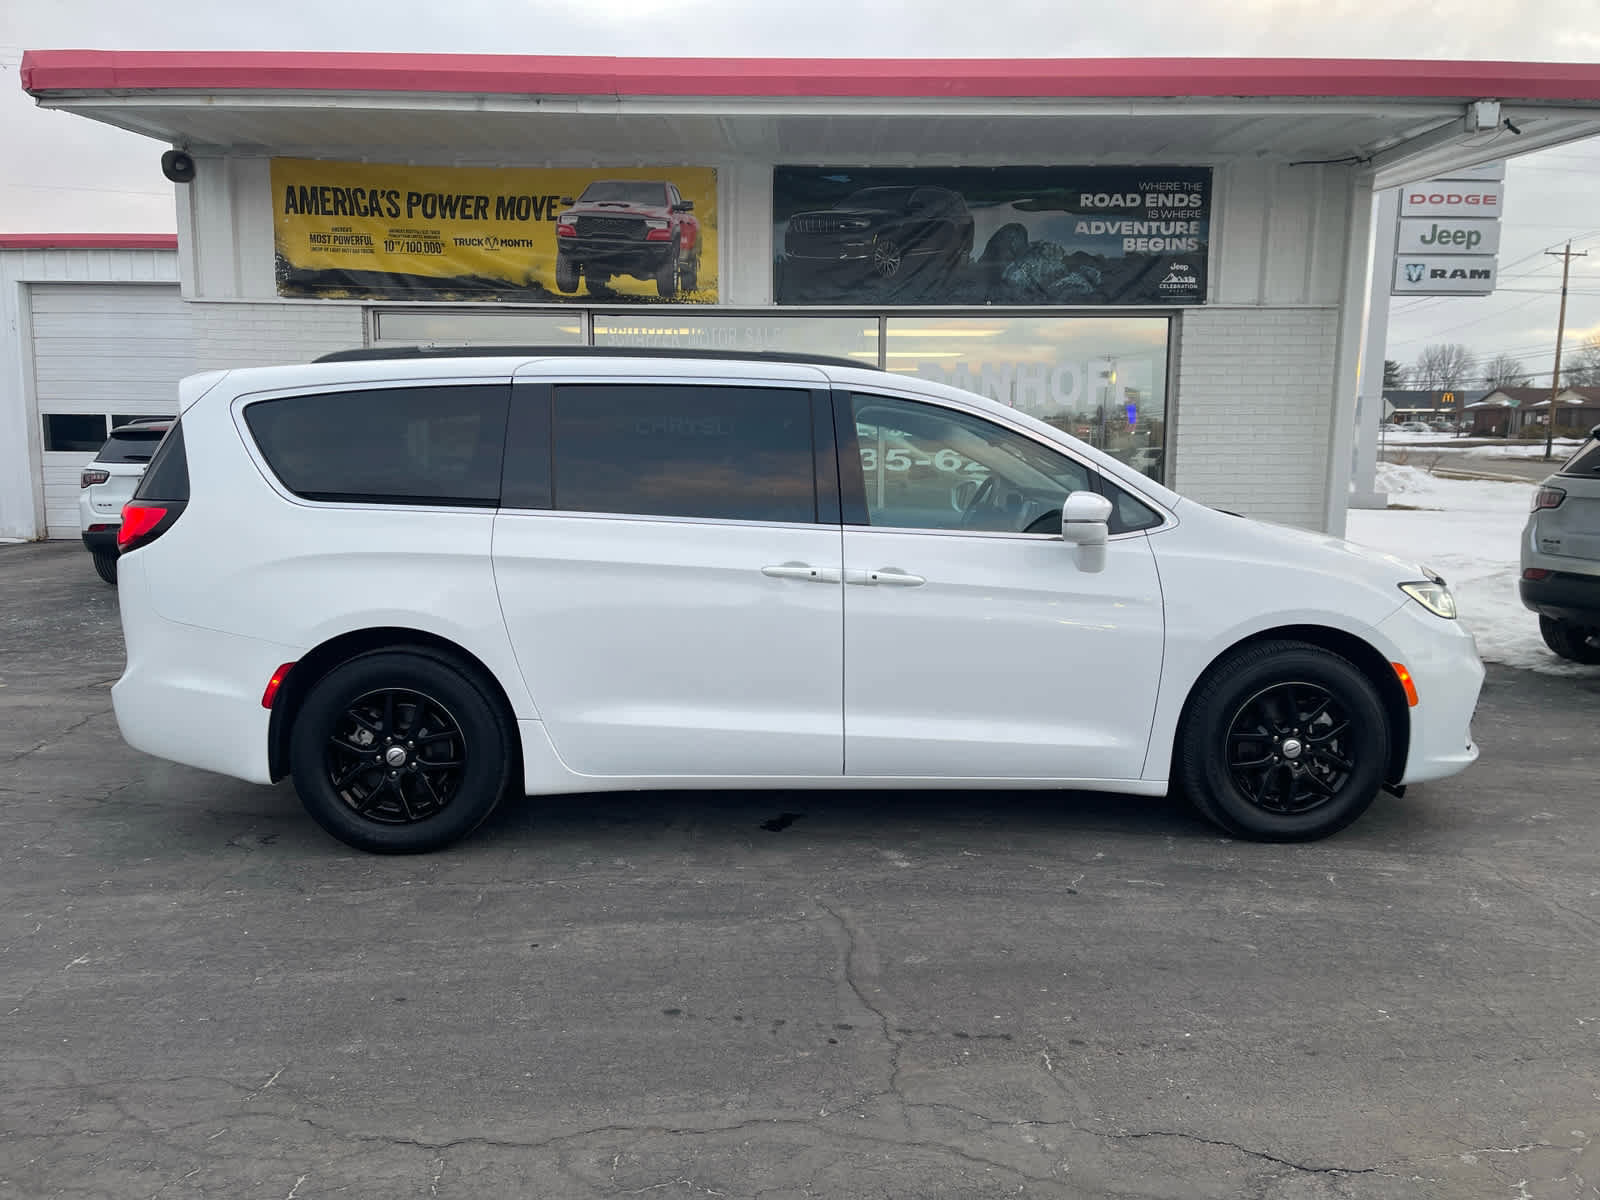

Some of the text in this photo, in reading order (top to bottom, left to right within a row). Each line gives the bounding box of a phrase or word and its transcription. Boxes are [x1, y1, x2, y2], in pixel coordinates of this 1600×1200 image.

[1139, 181, 1203, 192] WHERE THE
[284, 184, 560, 221] AMERICA'S POWER MOVE
[1079, 193, 1203, 208] ROAD ENDS
[1409, 193, 1497, 206] DODGE
[1148, 209, 1202, 219] IS WHERE
[1073, 221, 1200, 235] ADVENTURE
[309, 233, 374, 246] MOST POWERFUL
[453, 237, 533, 248] TRUCK MONTH
[1420, 223, 1482, 250] Jeep
[1123, 237, 1199, 252] BEGINS
[1170, 262, 1189, 271] Jeep
[1430, 268, 1491, 279] RAM
